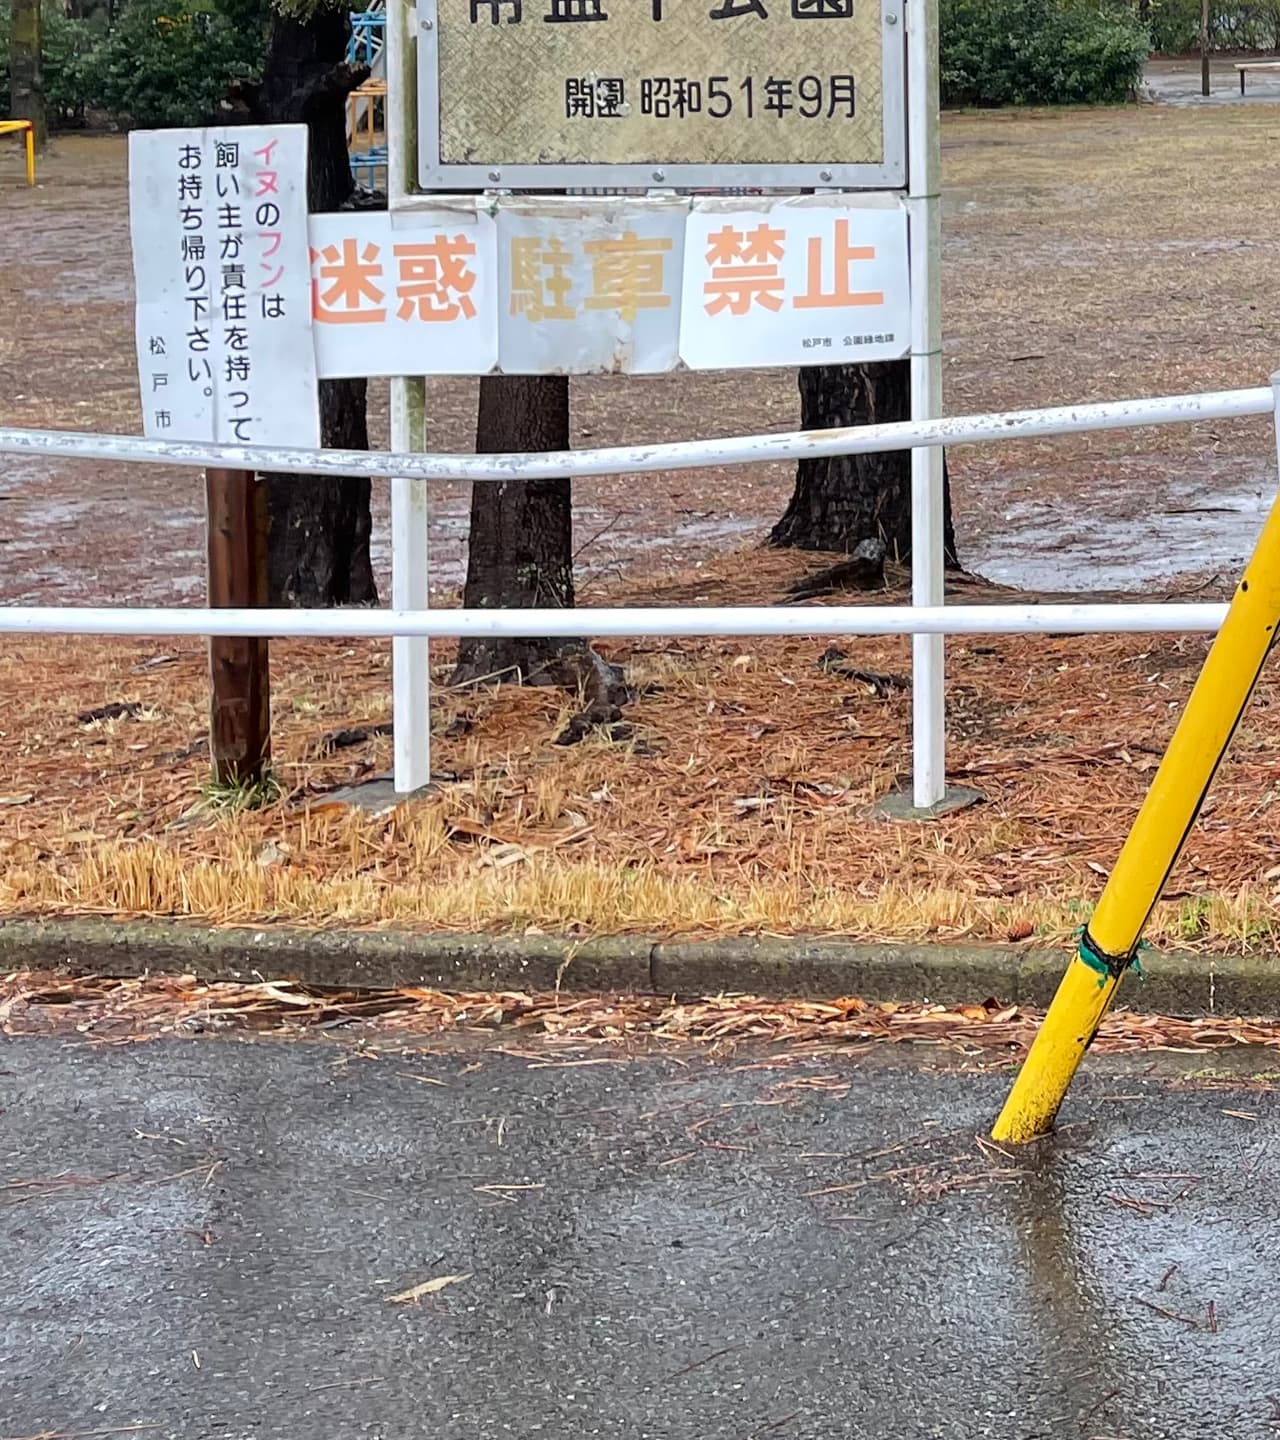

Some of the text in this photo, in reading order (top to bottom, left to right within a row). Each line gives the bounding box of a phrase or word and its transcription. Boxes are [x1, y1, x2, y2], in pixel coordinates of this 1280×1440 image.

[565, 75, 856, 118] 開園 昭和51年9月
[177, 144, 213, 398] お持ち帰り下さい。
[215, 141, 252, 442] 飼い主が責任を持って
[254, 139, 286, 320] イヌのフンは
[309, 218, 885, 325] 迷惑 駐車 禁止
[149, 335, 172, 429] 松戸市
